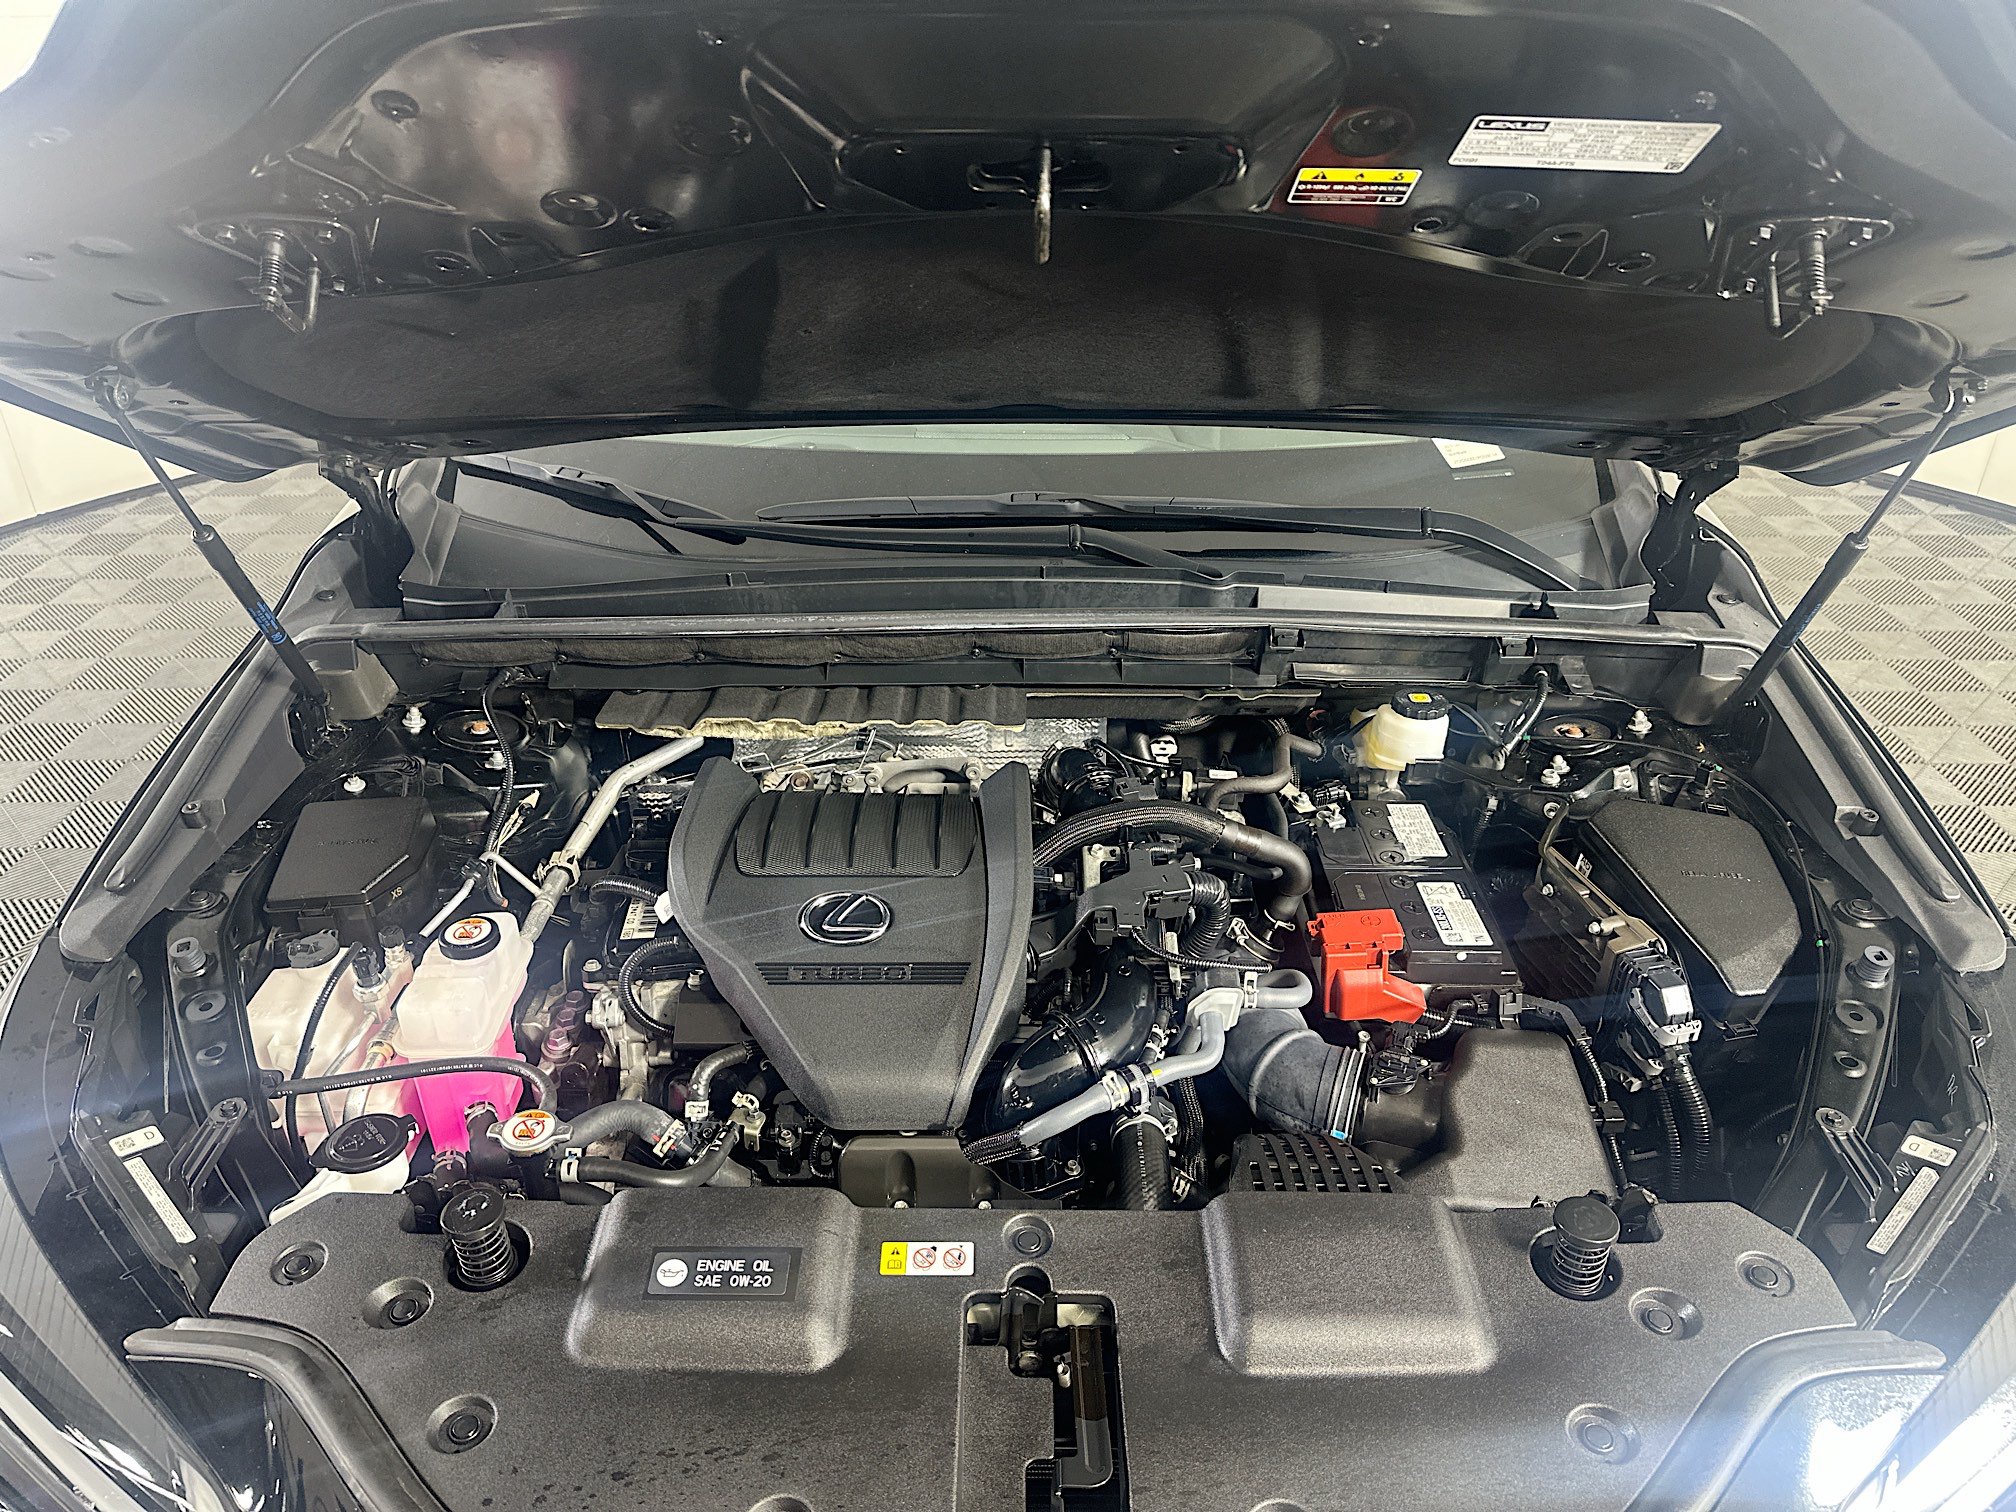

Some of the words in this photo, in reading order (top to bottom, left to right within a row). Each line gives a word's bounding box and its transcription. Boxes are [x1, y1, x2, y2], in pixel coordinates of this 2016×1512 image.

[1478, 121, 1547, 129] LEXUS
[390, 886, 403, 900] XS
[696, 1259, 746, 1272] ENGINE
[752, 1260, 774, 1272] OIL
[693, 1275, 722, 1287] SAE
[729, 1275, 772, 1287] 0W-20
